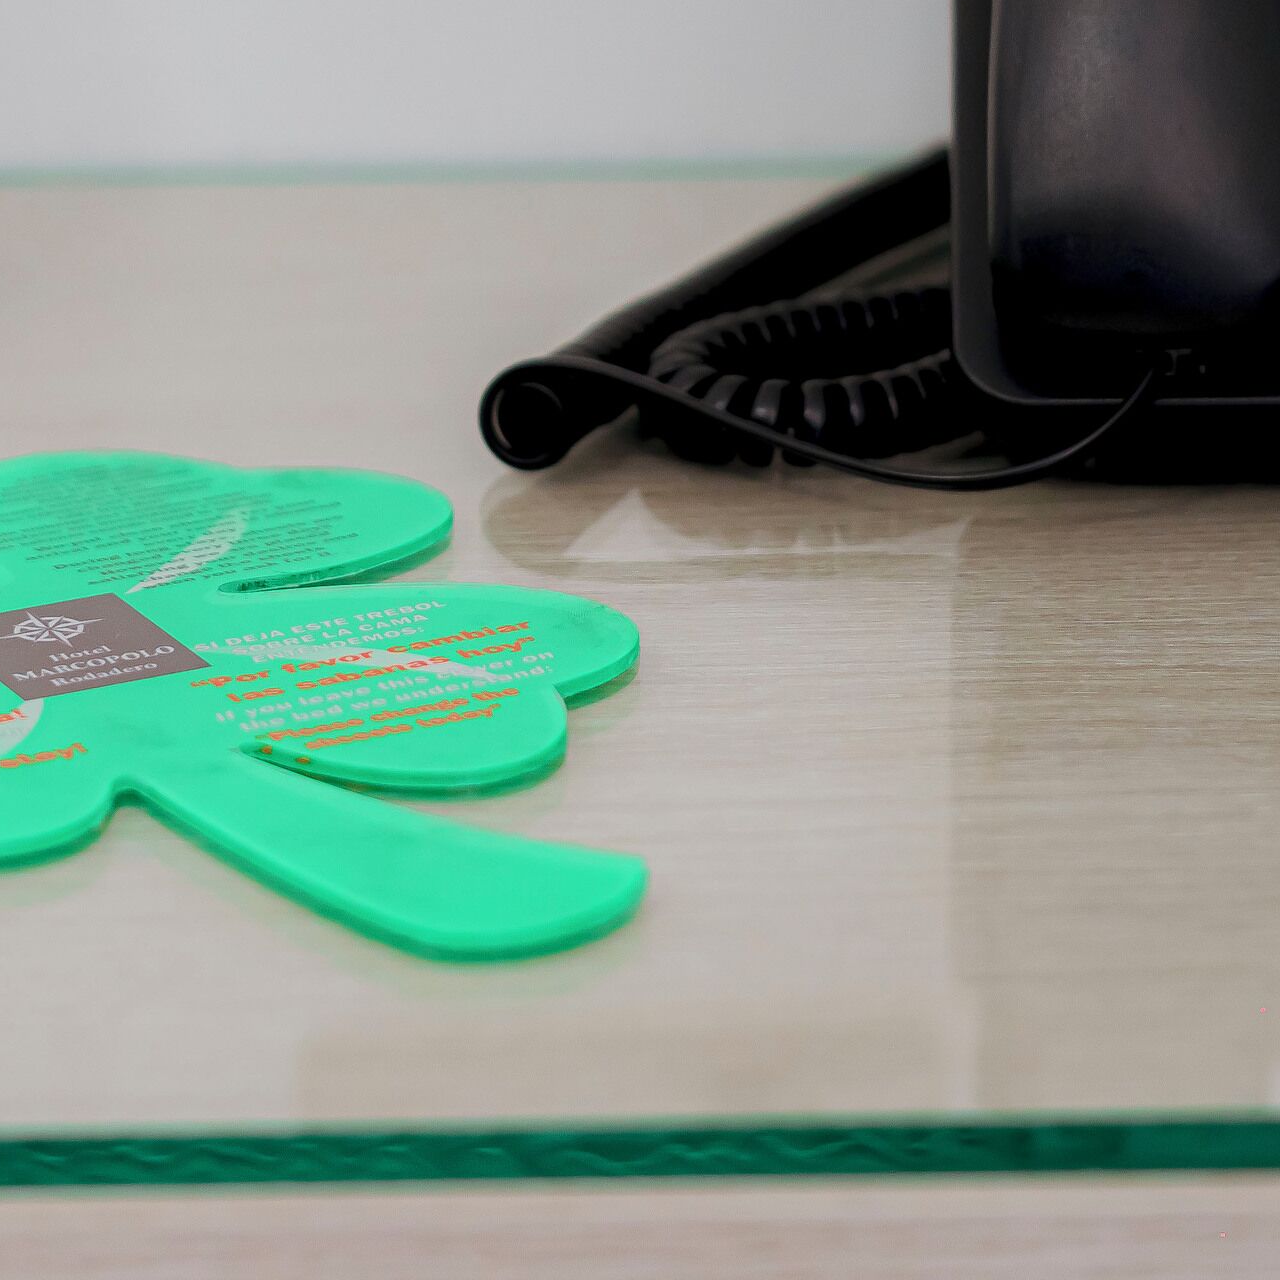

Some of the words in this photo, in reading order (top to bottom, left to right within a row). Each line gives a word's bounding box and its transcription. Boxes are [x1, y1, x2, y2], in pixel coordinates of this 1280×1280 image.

[195, 640, 220, 652] SI
[224, 629, 286, 647] DEJA
[290, 617, 349, 634] ESTE
[233, 634, 313, 656] SOBRE
[322, 627, 354, 641] LA
[358, 614, 429, 632] CAMA
[281, 651, 375, 675] favor
[386, 621, 531, 655] cambiar
[11, 645, 176, 682] MARCOPOLO
[49, 645, 113, 663] Hotel
[50, 662, 159, 688] Rodadero
[226, 686, 287, 703] las
[295, 655, 452, 691] sabanas
[247, 701, 293, 720] you
[298, 686, 372, 706] leave
[377, 673, 431, 691] this
[522, 651, 556, 664] on
[239, 716, 287, 732] the
[291, 703, 343, 721] bed
[350, 697, 388, 711] we
